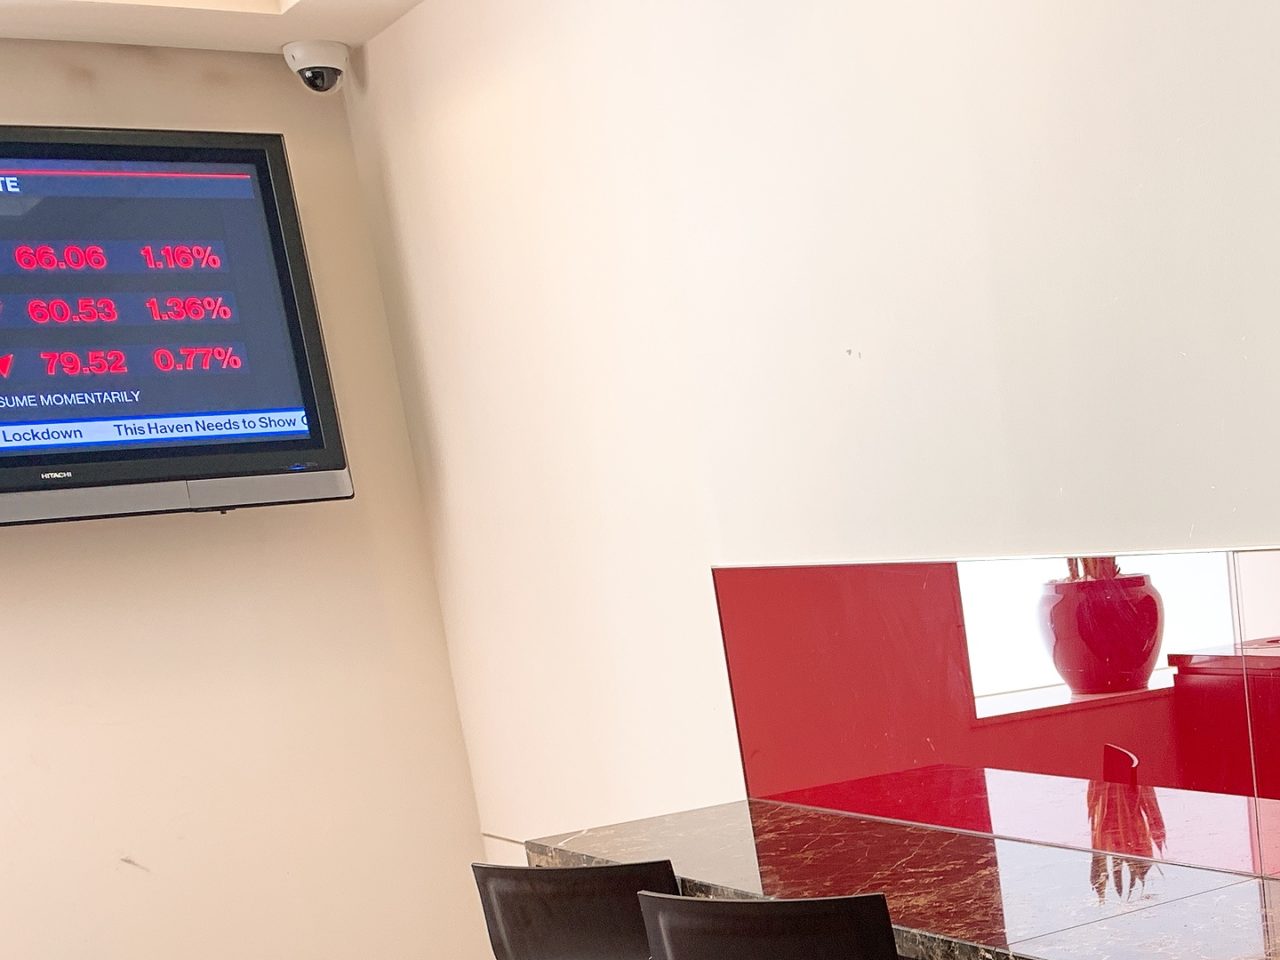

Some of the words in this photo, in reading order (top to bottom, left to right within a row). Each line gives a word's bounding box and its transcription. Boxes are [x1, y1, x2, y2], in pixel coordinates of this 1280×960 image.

[14, 245, 107, 270] 66.06
[140, 244, 221, 269] 1.16%
[27, 299, 118, 324] 60.53
[145, 297, 232, 321] 1.36%
[40, 350, 128, 376] 79.52
[153, 347, 242, 372] 0.77%
[40, 390, 140, 406] MOMENTARILY
[2, 428, 83, 443] Lockdown
[113, 422, 146, 437] This
[147, 419, 193, 434] Haven
[195, 417, 240, 433] Needs
[242, 416, 257, 430] to
[258, 414, 296, 430] Show
